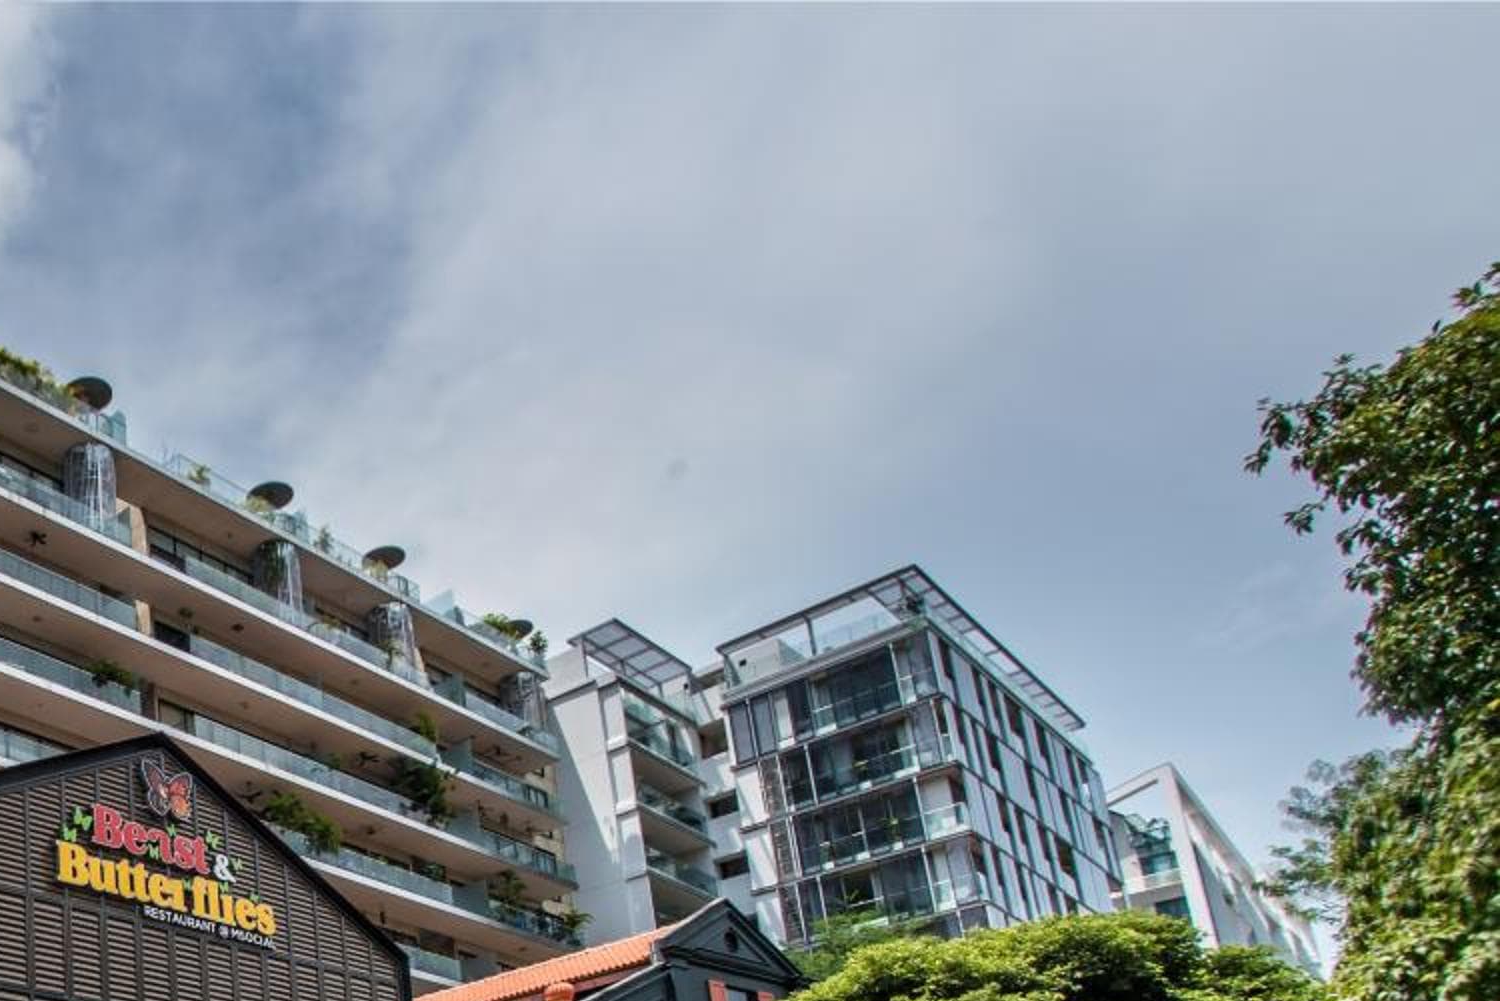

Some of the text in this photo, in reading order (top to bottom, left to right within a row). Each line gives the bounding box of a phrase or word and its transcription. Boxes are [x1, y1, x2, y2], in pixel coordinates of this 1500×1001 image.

[91, 803, 236, 883] Beast &
[143, 905, 216, 933] RESTAURANT
